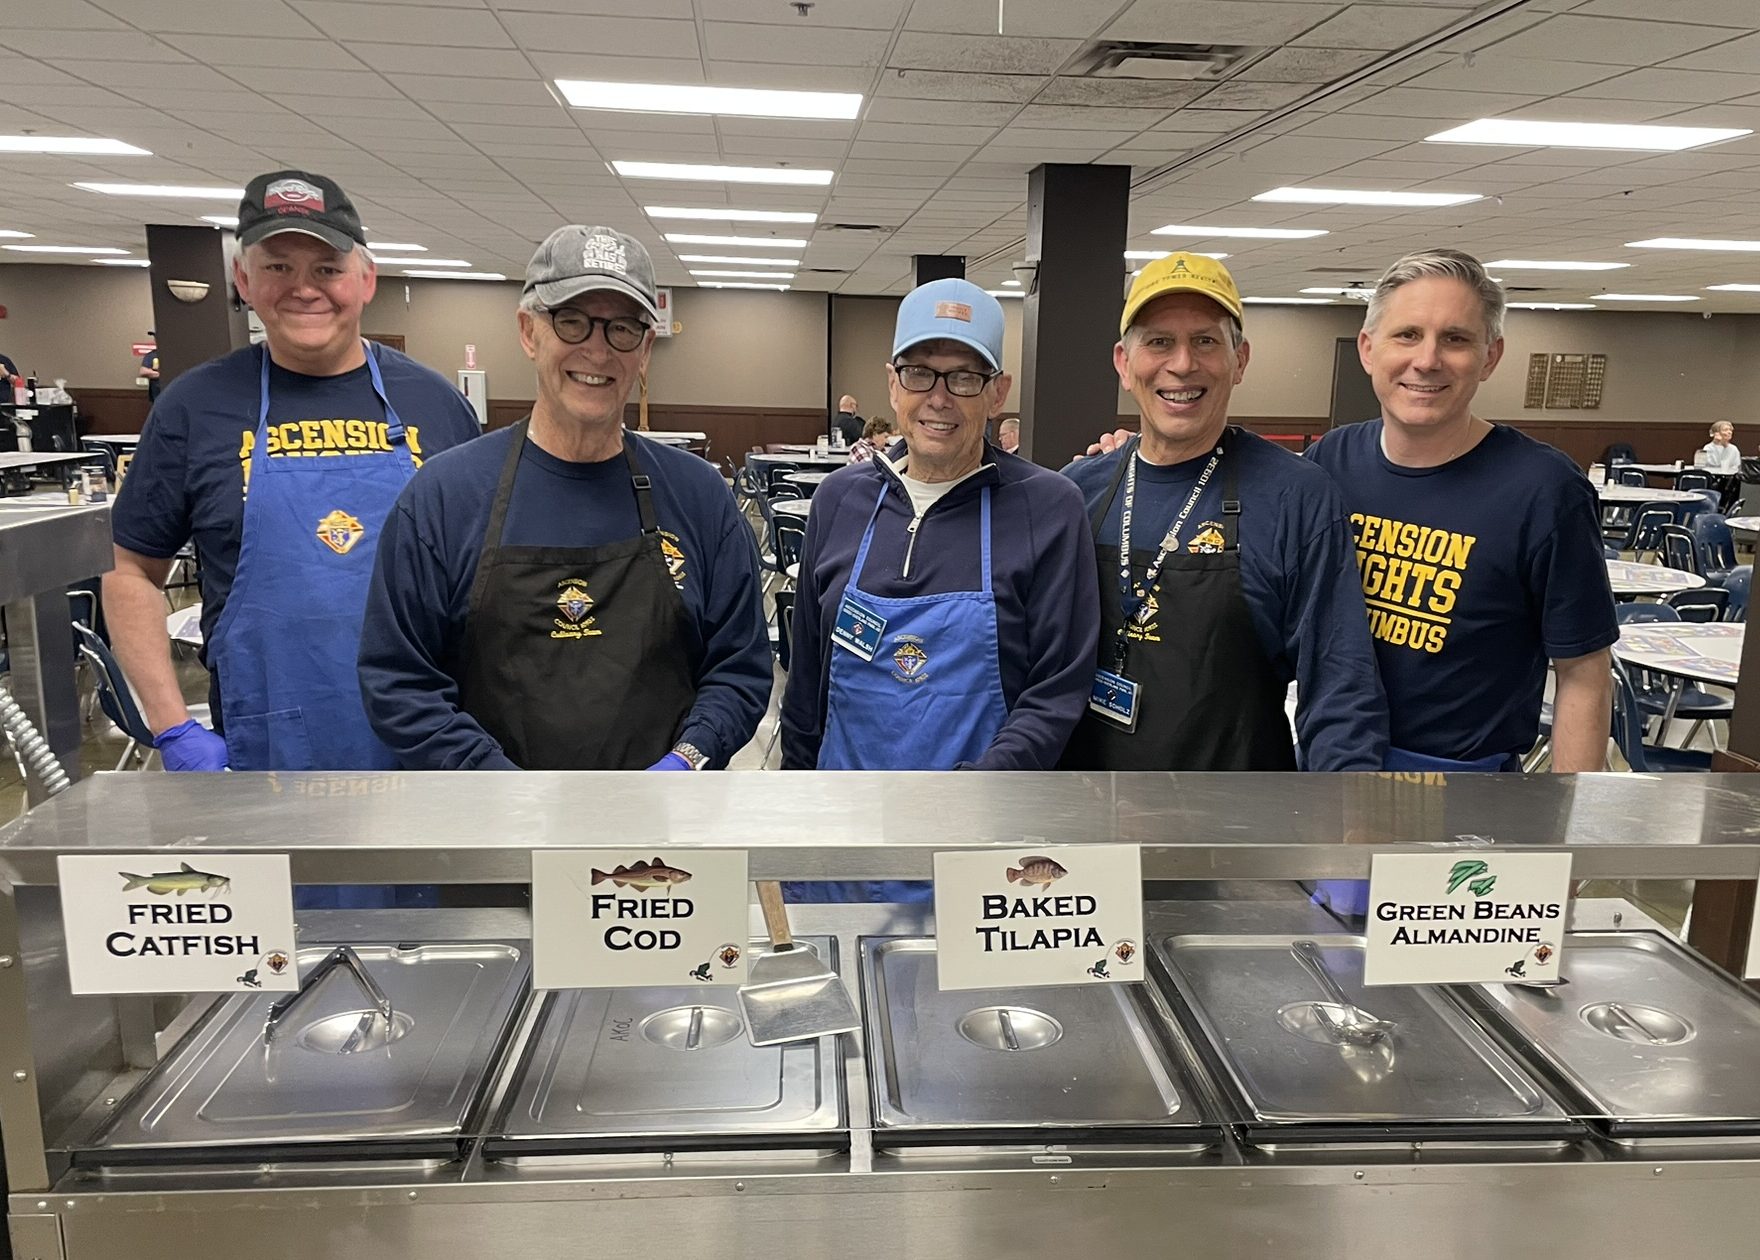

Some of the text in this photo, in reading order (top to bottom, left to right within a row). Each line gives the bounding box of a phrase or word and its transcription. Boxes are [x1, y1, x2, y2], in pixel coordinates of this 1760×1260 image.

[1178, 486, 1202, 520] Council
[1198, 456, 1220, 486] 10932
[1120, 510, 1132, 567] COLUMBUS
[128, 904, 232, 924] FRIED
[591, 893, 694, 919] FRIED
[982, 894, 1097, 920] BAKED
[1376, 901, 1560, 921] GREEN BEANS
[106, 931, 260, 957] CATFISH
[604, 926, 681, 951] COD
[976, 926, 1105, 952] TILAPIA
[1390, 926, 1541, 945] ALMANDINE
